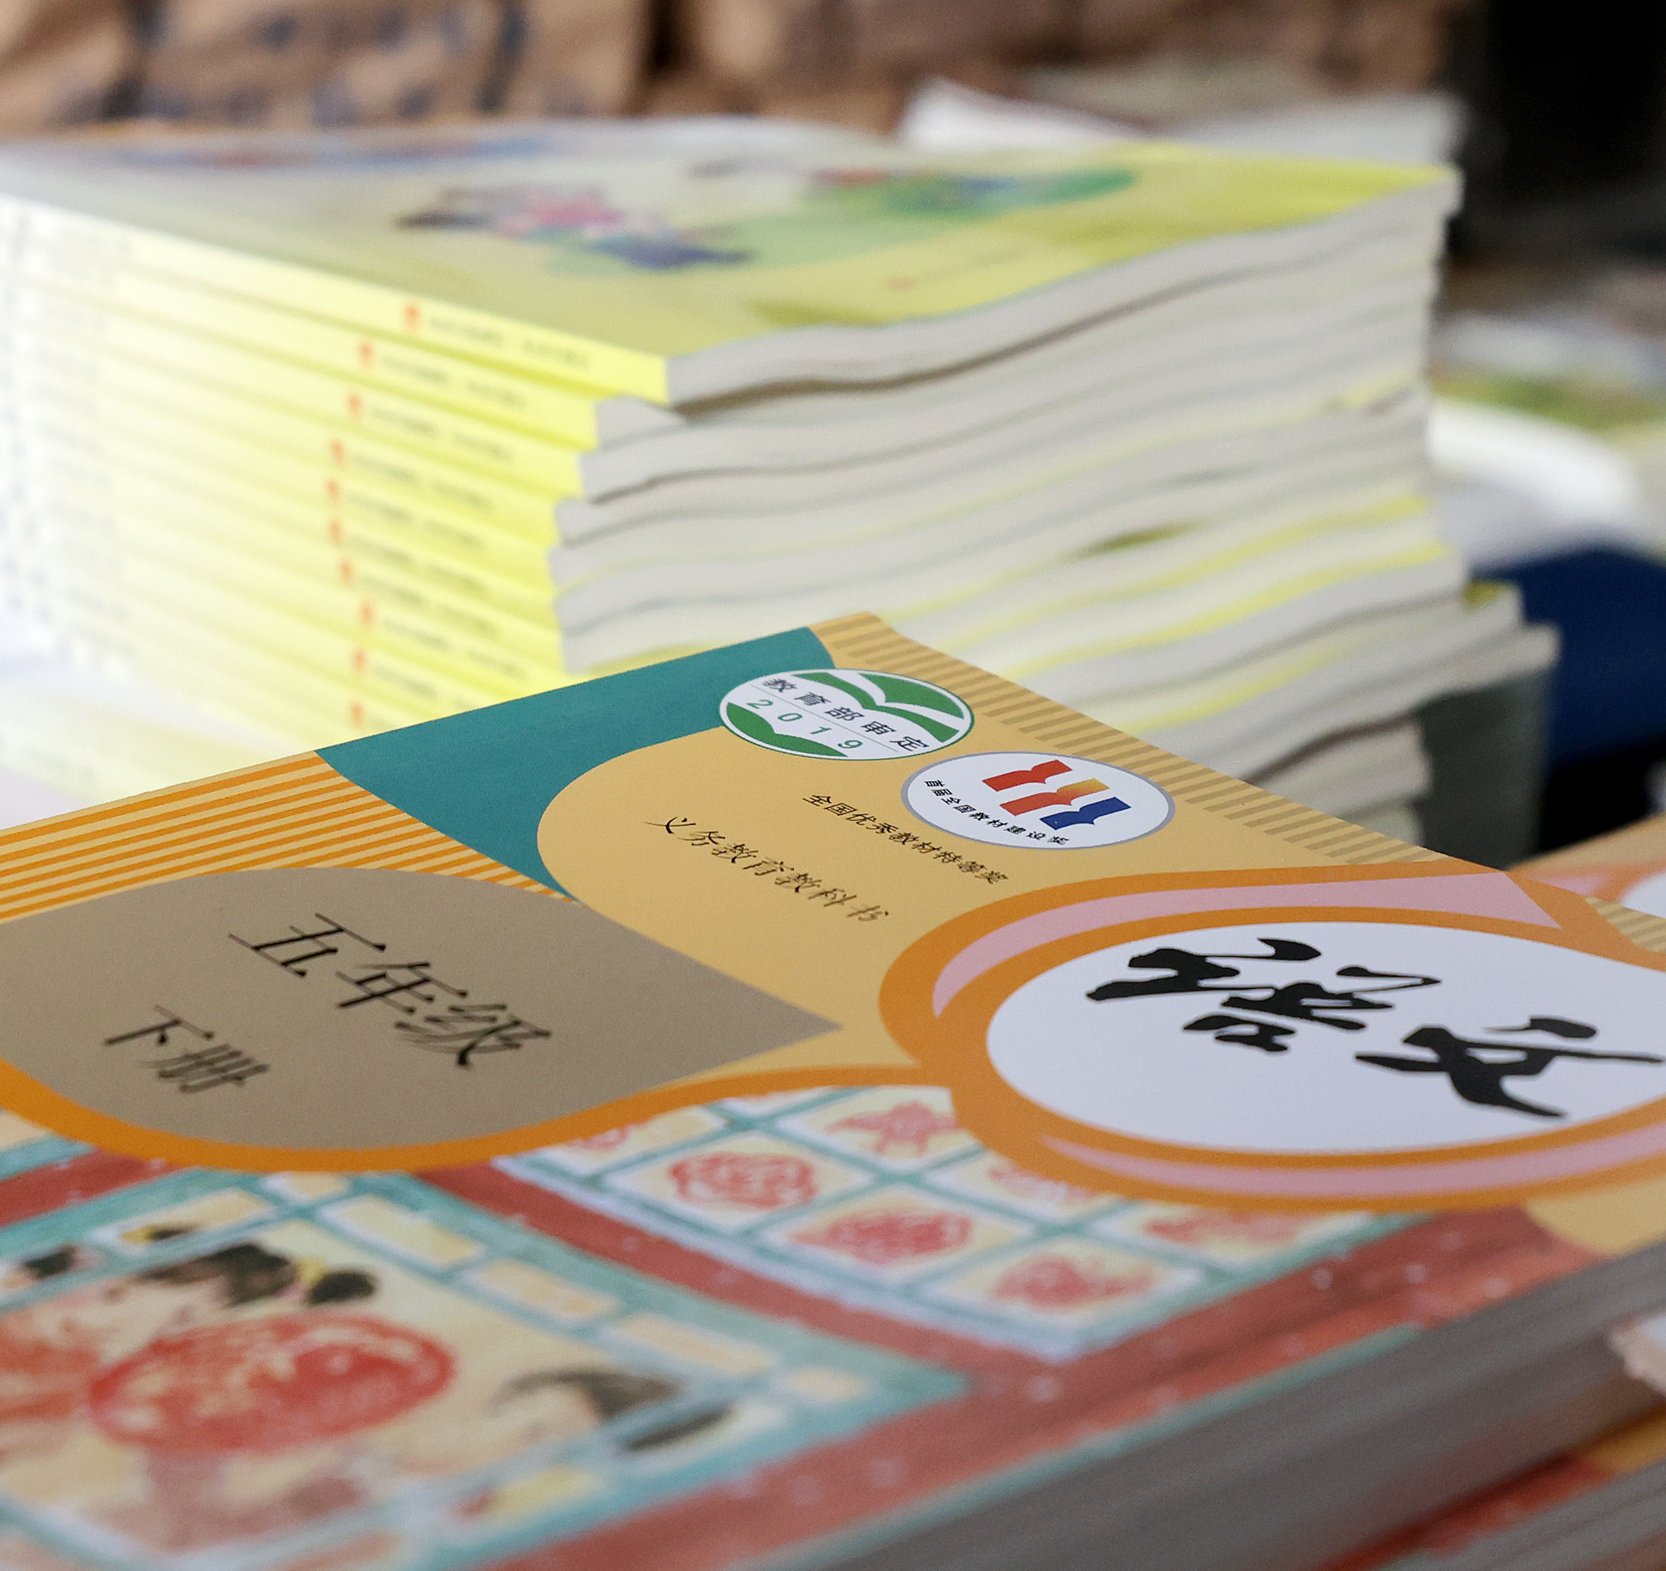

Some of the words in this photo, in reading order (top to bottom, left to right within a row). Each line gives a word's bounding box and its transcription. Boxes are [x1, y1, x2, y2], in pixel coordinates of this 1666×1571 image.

[746, 697, 865, 752] 2019
[763, 677, 930, 753] 教育部审定
[802, 793, 1009, 885] 全国优秀教材特等奖
[924, 778, 1071, 846] 首届全国教材建设奖
[644, 815, 889, 923] 义务教育教科书
[228, 913, 552, 1067] 五年级
[104, 1005, 270, 1093] 下册
